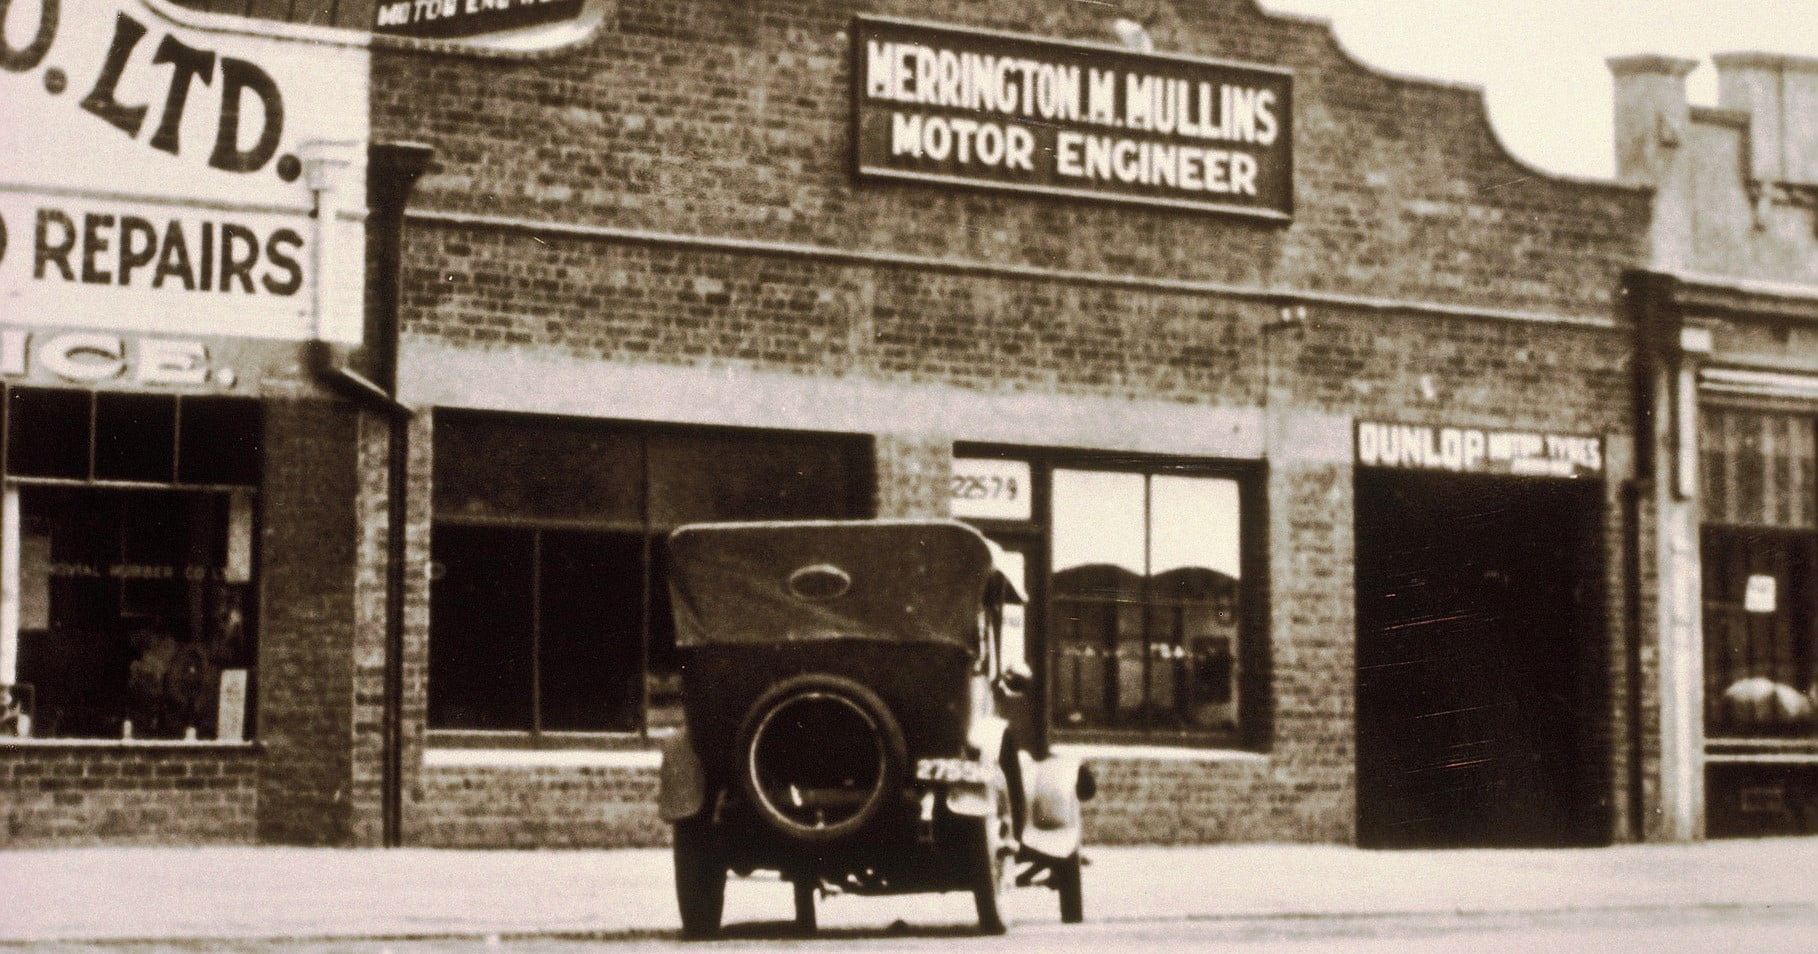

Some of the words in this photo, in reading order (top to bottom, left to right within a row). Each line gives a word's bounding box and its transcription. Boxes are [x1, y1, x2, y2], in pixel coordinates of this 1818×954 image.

[79, 11, 302, 183] LTD.
[1126, 72, 1277, 145] MULLINS
[892, 112, 1034, 170] MOTOR
[1057, 131, 1257, 195] ENGINEER
[34, 208, 304, 296] REPAIRS
[1359, 422, 1484, 471] DUNLOP
